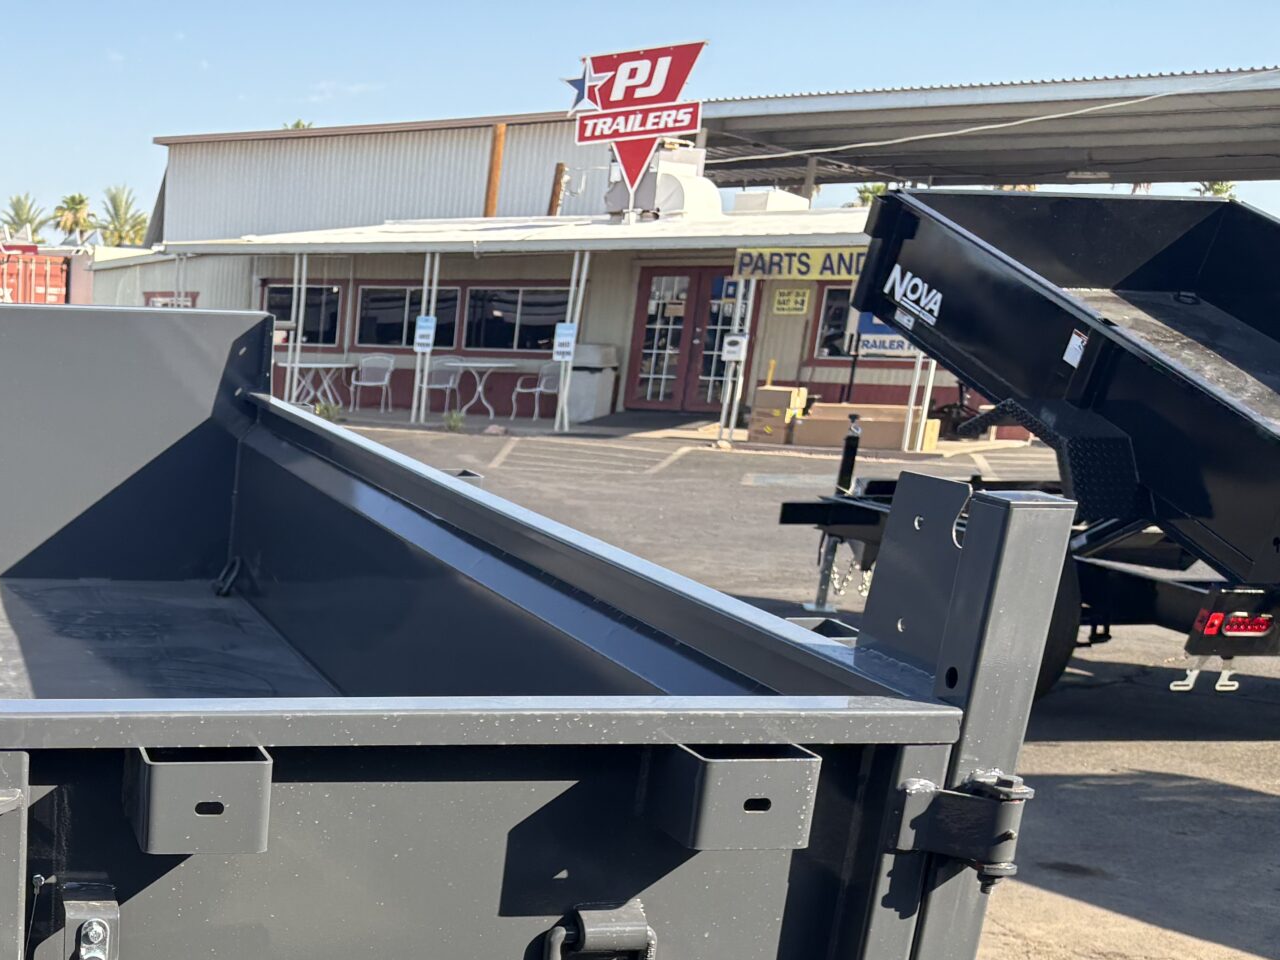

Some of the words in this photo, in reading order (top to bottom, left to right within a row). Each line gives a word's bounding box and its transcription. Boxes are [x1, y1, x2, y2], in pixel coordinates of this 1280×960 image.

[609, 56, 673, 102] PJ
[583, 107, 695, 138] TRAILERS
[737, 252, 812, 276] PARTS
[882, 263, 943, 318] NOVA
[860, 339, 906, 351] RAILER
